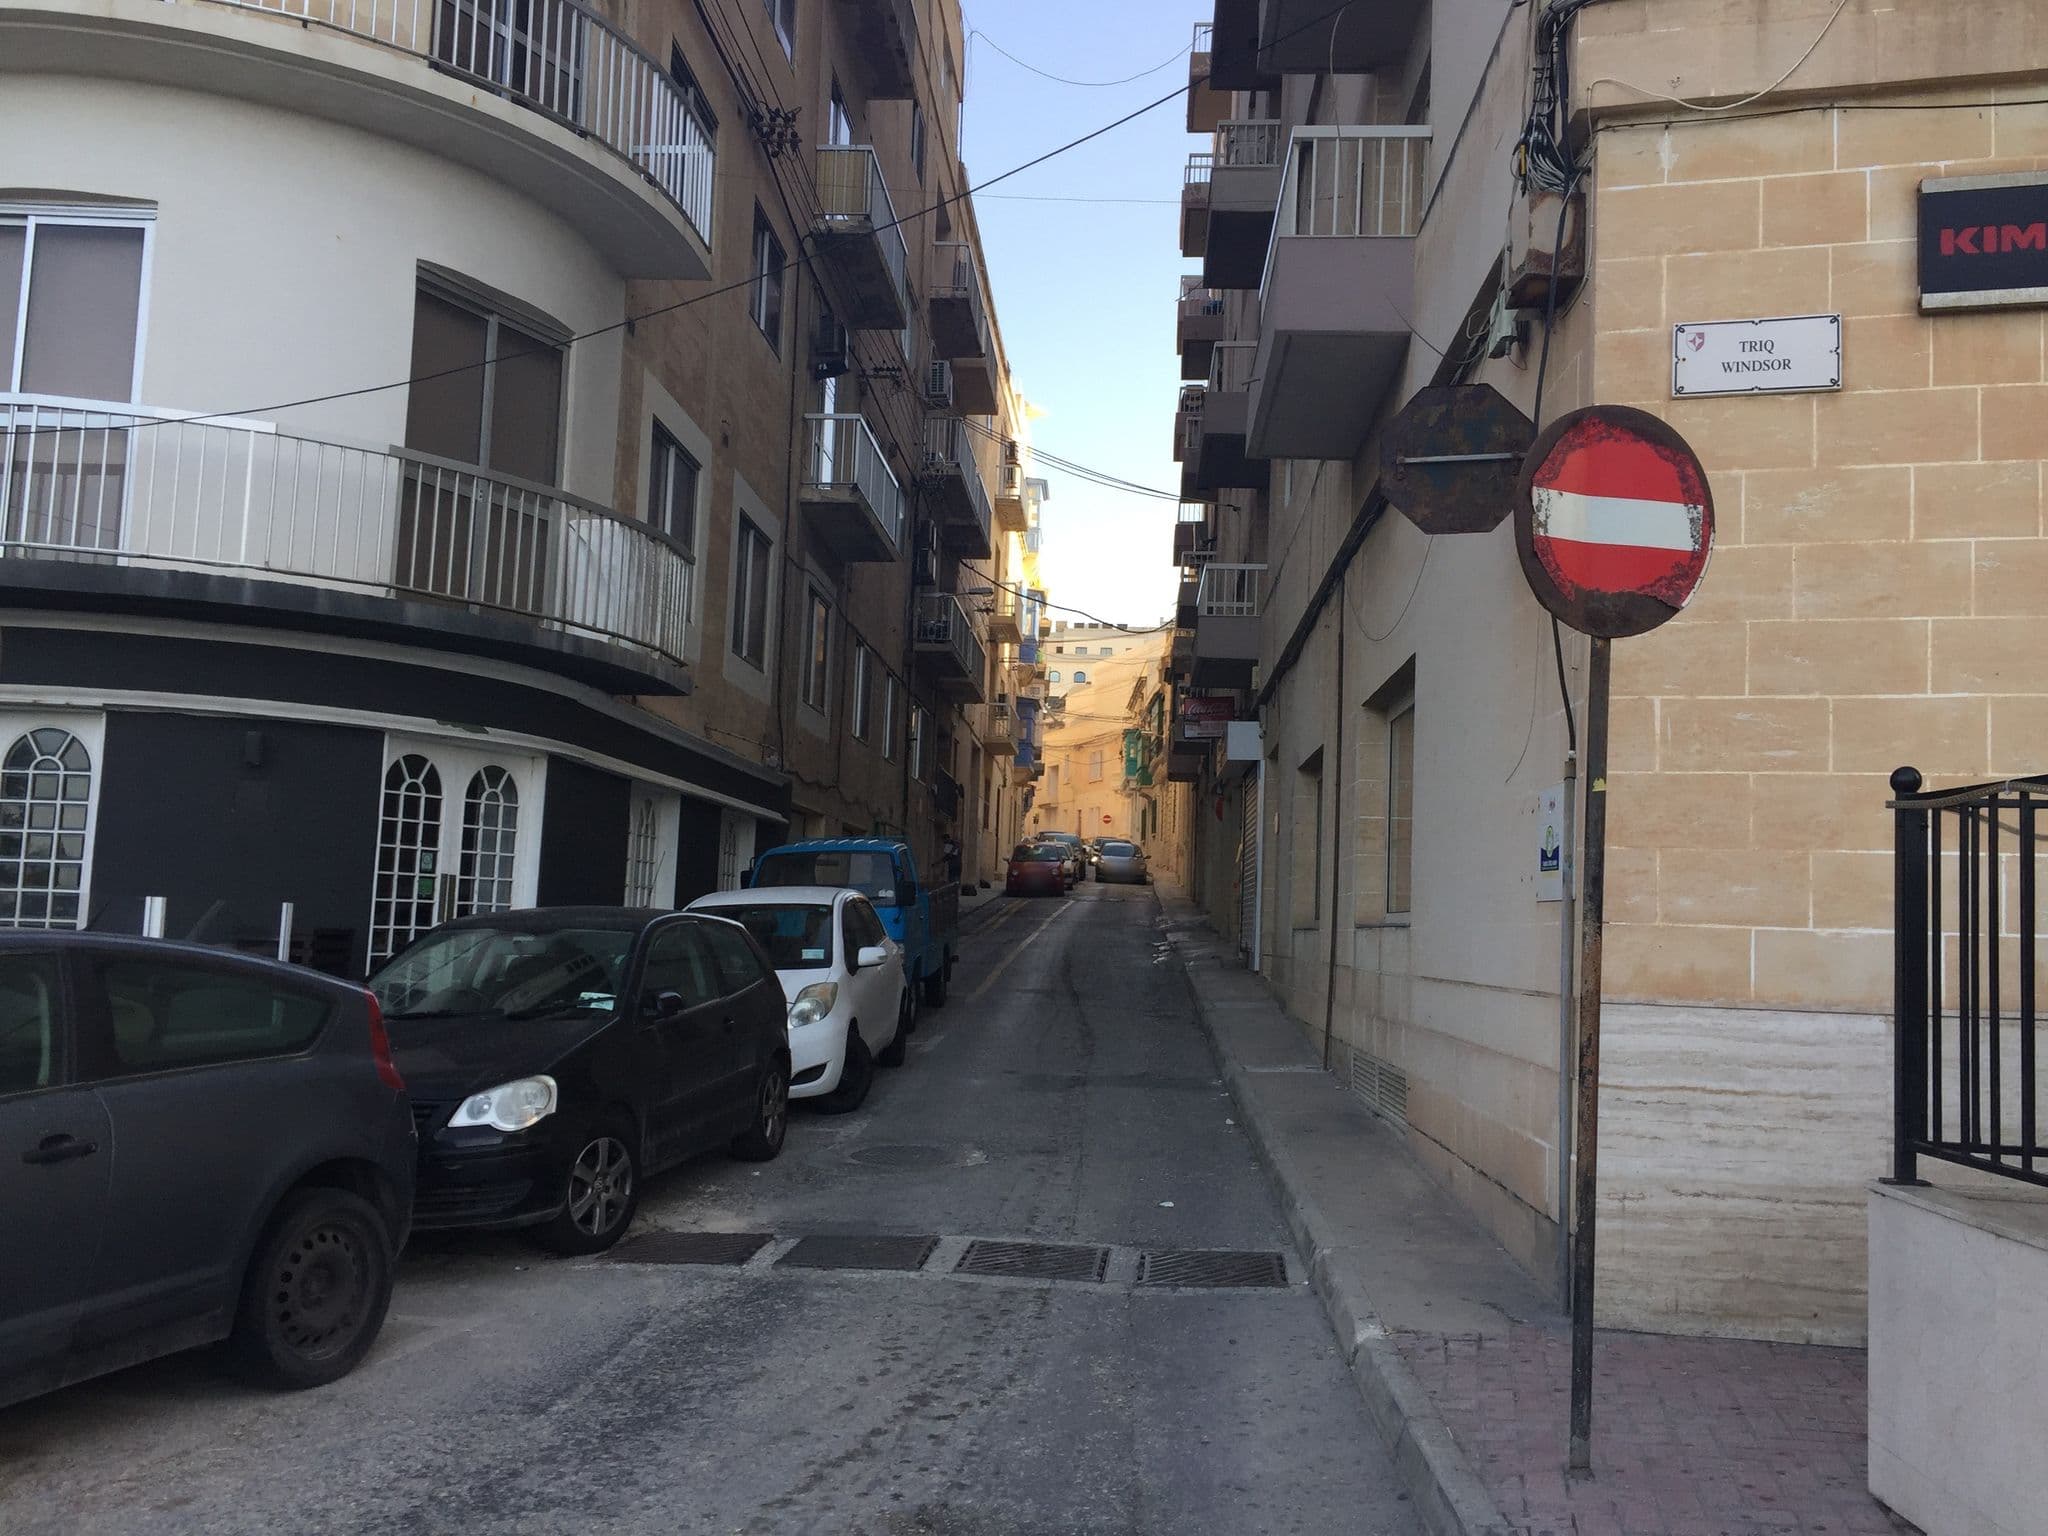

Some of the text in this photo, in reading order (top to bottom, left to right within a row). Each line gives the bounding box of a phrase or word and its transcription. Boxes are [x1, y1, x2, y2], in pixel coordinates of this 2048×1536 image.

[1941, 222, 2046, 256] KIM
[1739, 339, 1775, 355] TRIQ
[1721, 358, 1792, 373] WINDSOR
